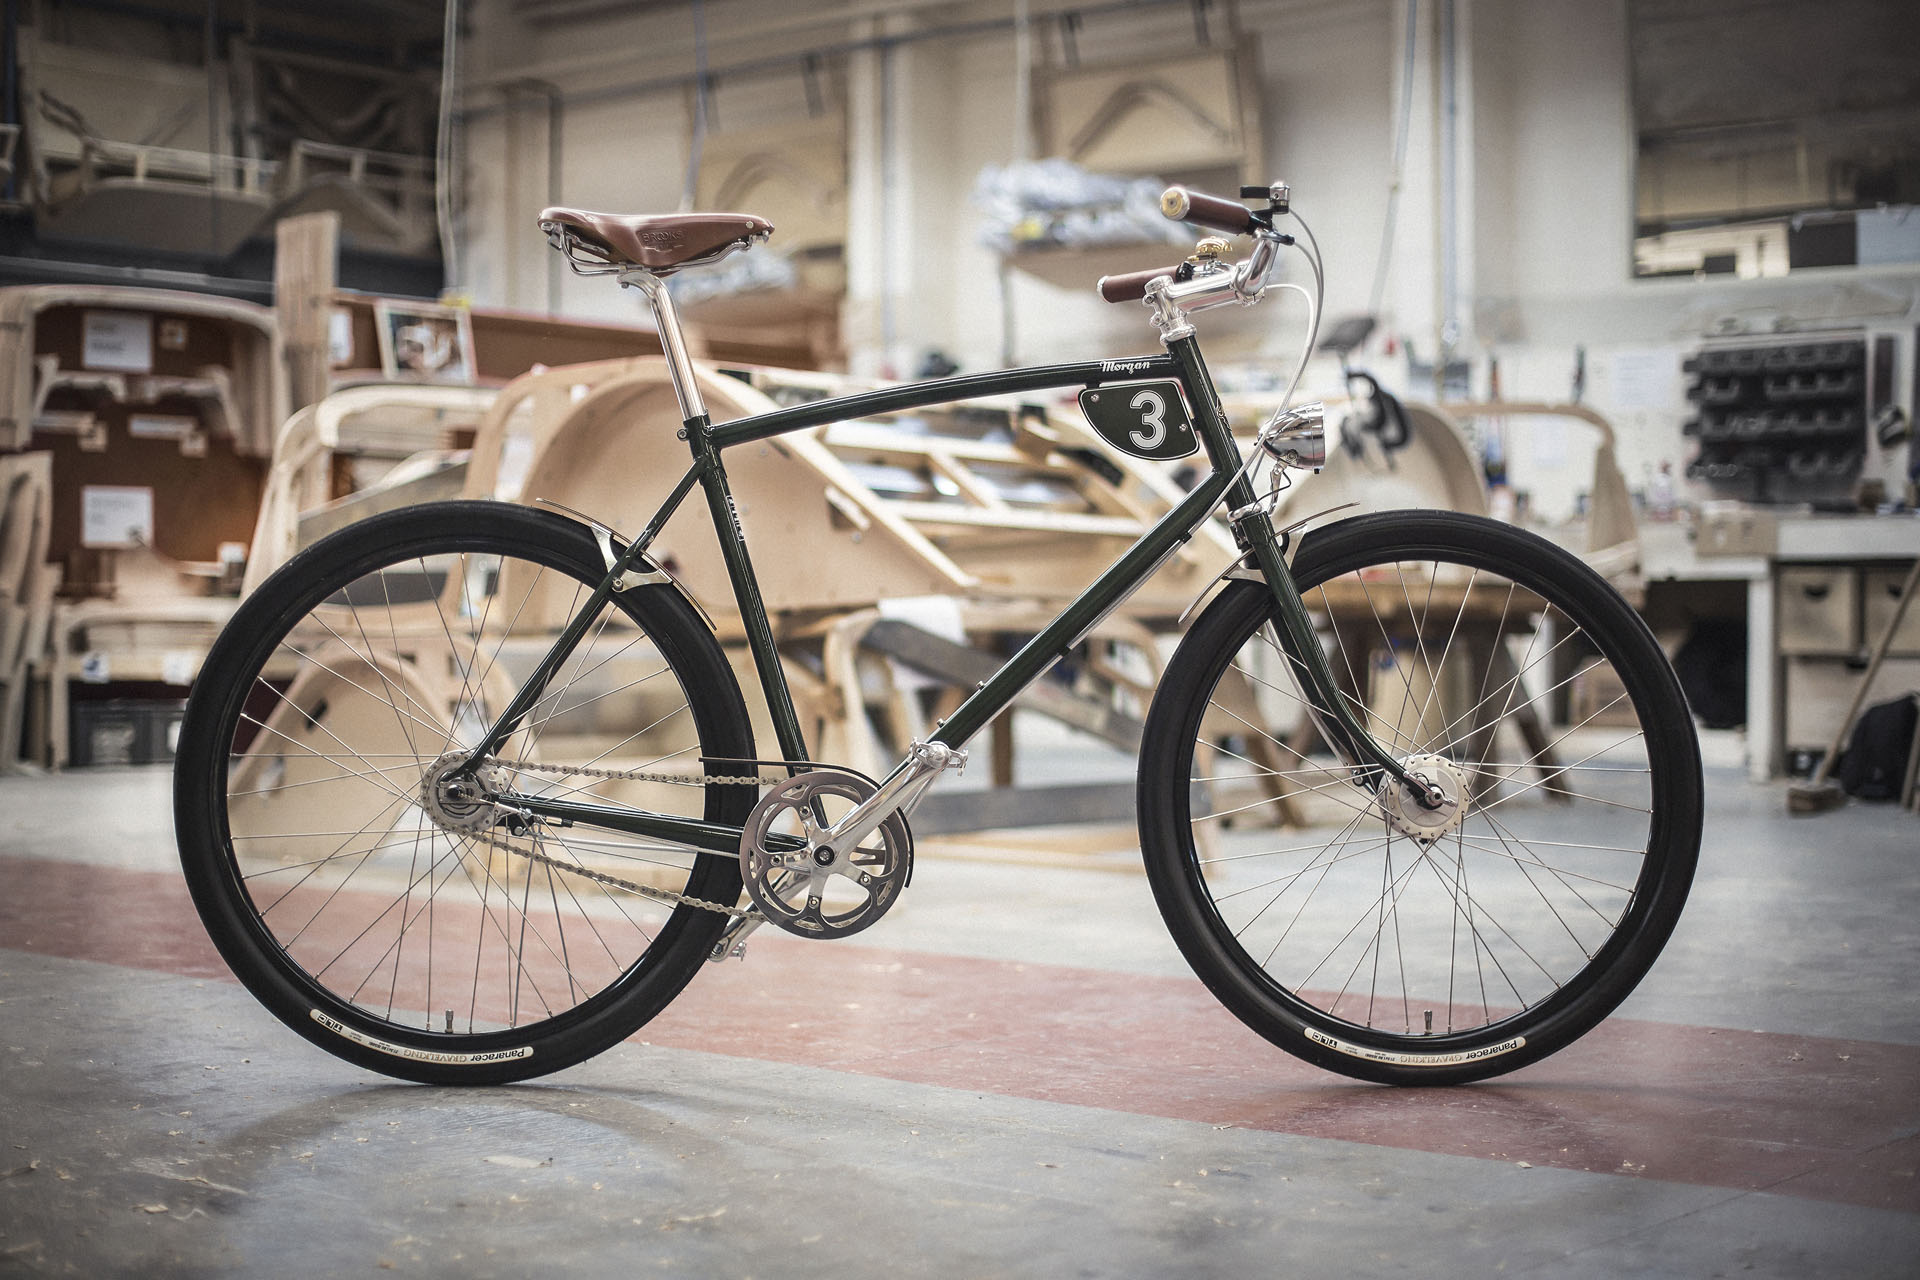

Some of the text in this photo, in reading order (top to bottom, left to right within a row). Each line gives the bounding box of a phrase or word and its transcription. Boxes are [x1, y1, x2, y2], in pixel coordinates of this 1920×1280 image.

[1100, 361, 1150, 374] Morgan
[1129, 389, 1166, 450] 3
[317, 1014, 342, 1032] TLC
[1312, 1032, 1337, 1048] TLC
[403, 1048, 525, 1063] Panaracer GRAVELKING
[1466, 1040, 1517, 1060] Panaracer
[1400, 1055, 1463, 1064] GRAVELKING
